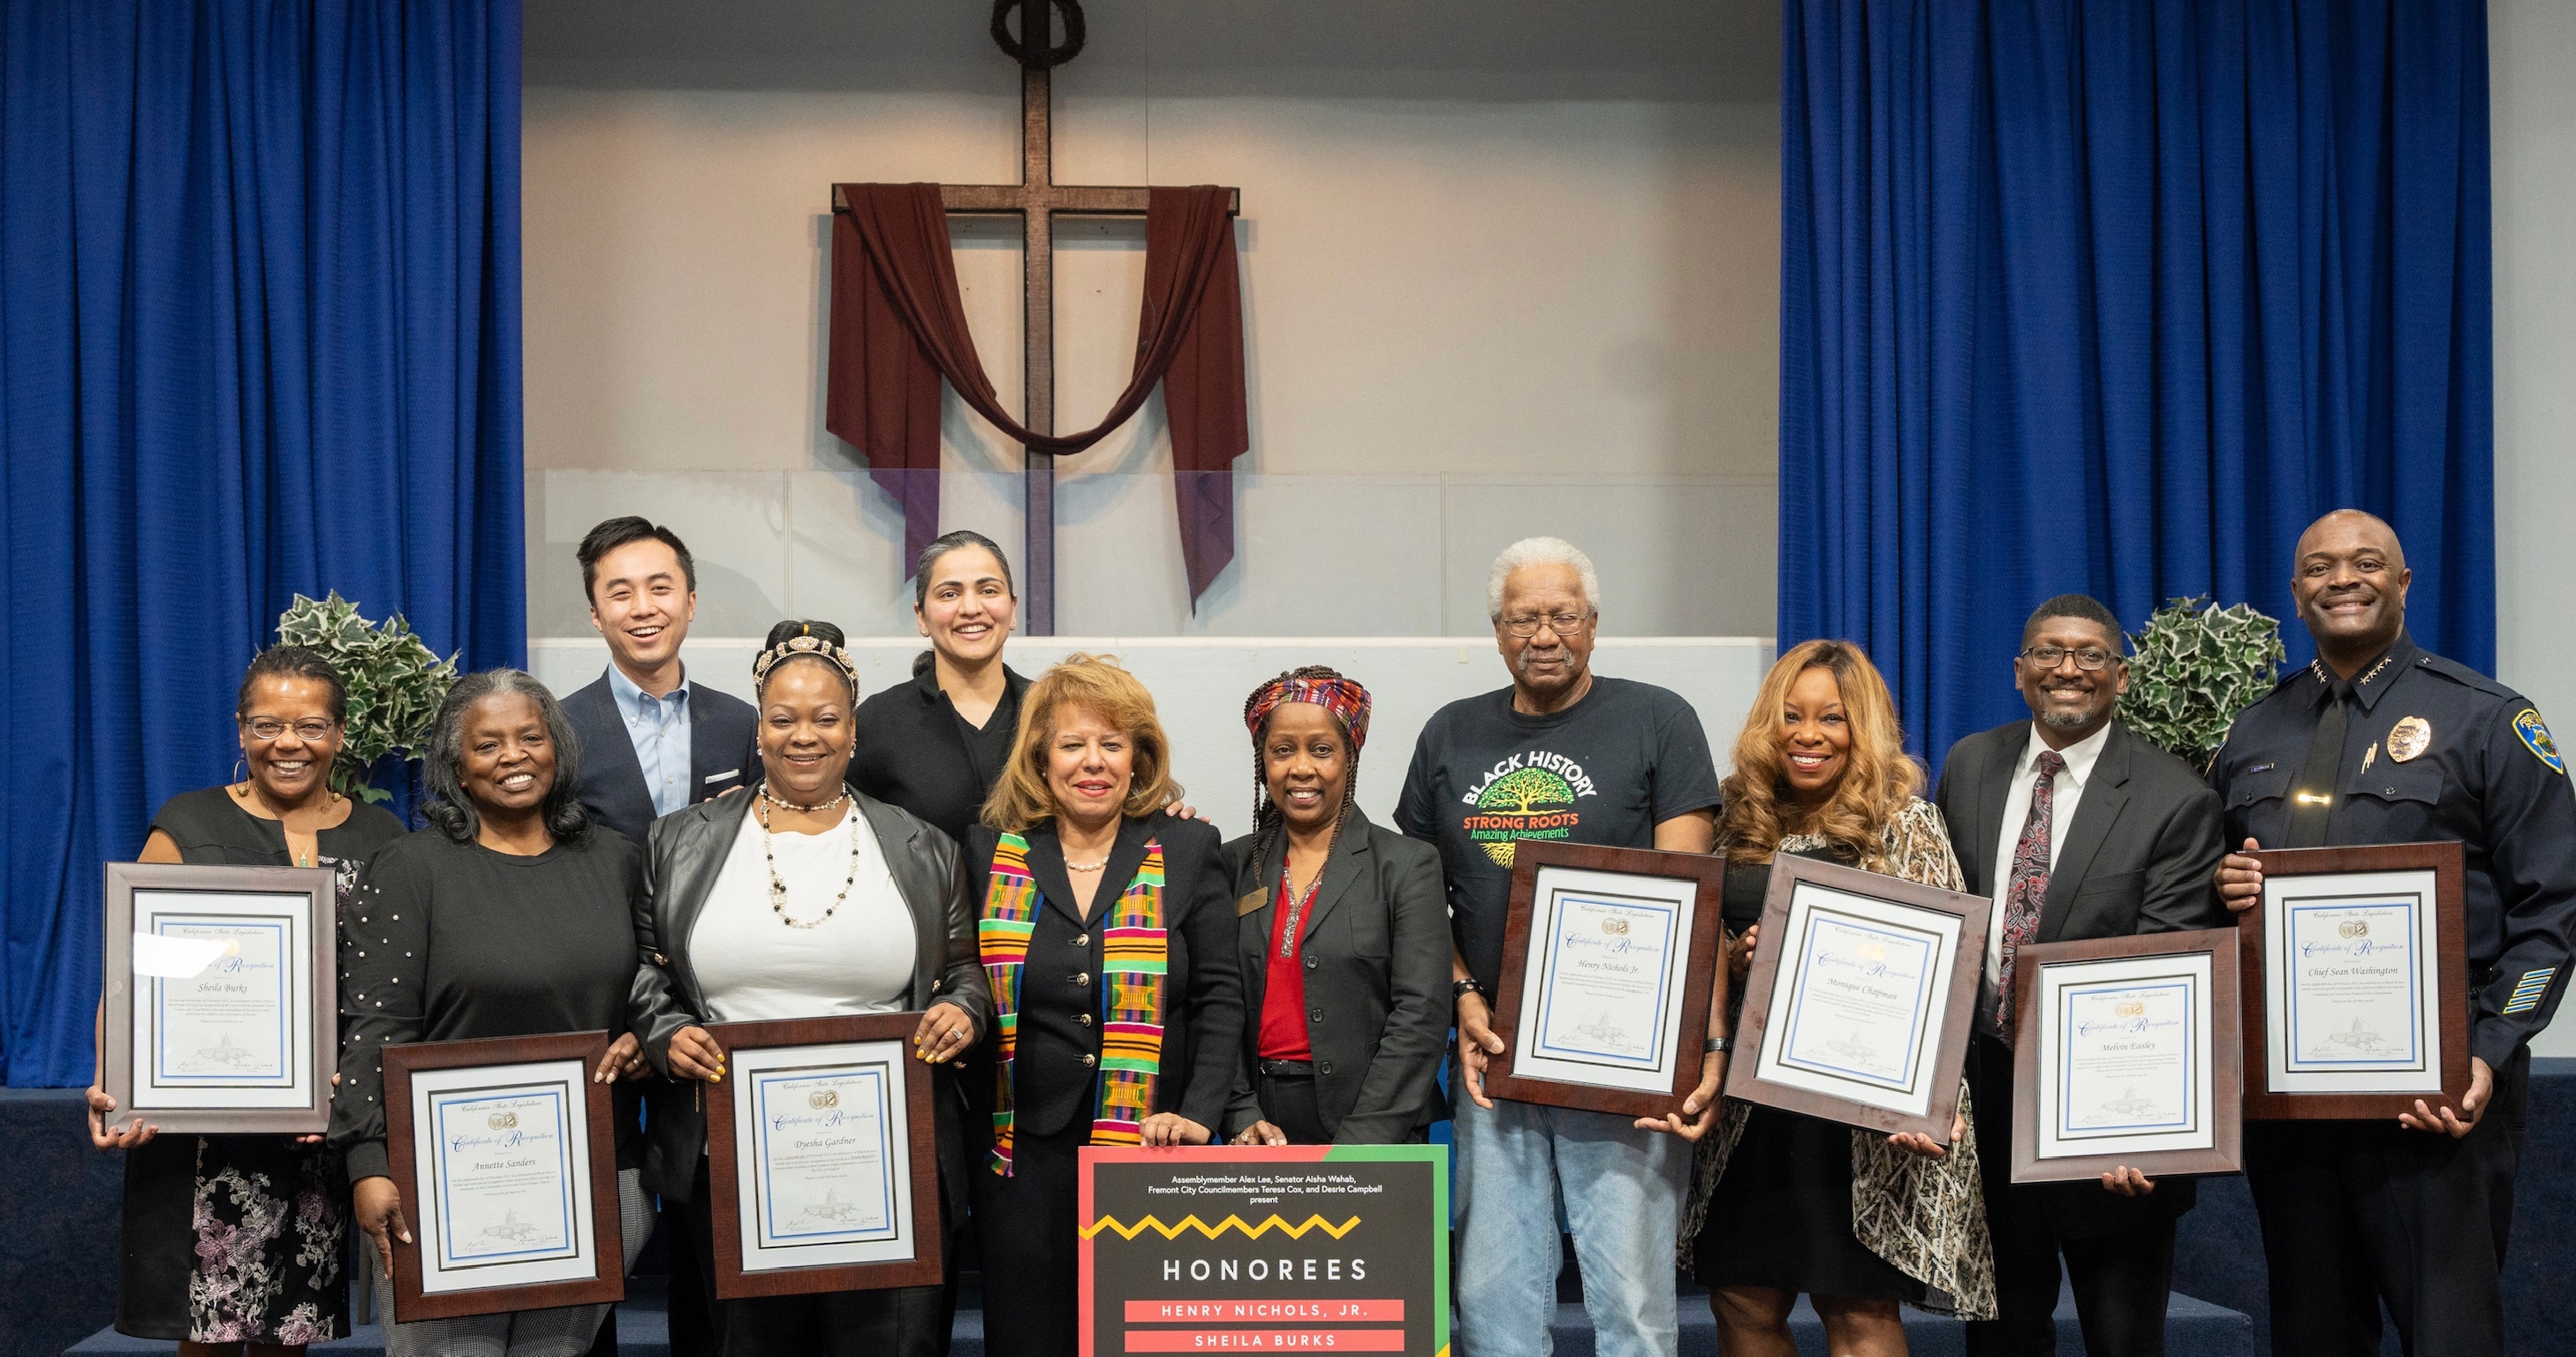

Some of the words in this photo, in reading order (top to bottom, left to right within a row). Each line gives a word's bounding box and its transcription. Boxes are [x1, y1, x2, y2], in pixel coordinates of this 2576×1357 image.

[1462, 753, 1523, 805] BLACK
[1527, 751, 1597, 798] HISTORY
[1463, 816, 1525, 829] STRONG
[1528, 813, 1579, 829] ROOTS
[1470, 829, 1508, 841] Amazing
[1510, 827, 1569, 839] Achievements
[1580, 905, 1607, 914] California
[1625, 909, 1654, 919] Legislature
[1565, 930, 1602, 949] Certificate
[1603, 940, 1612, 950] of
[1612, 936, 1660, 954] Recognition
[1834, 926, 1862, 936] California
[1881, 936, 1912, 947] Legislature
[2301, 940, 2342, 958] Certificate
[2344, 942, 2352, 953] of
[2353, 938, 2404, 956] Recognition
[214, 960, 224, 970] of
[224, 956, 274, 974] Recognition
[1578, 960, 1600, 971] Henry
[1601, 963, 1629, 973] Nichols
[1817, 950, 1857, 967] Certificate
[1858, 962, 1867, 971] of
[1867, 960, 1916, 980] Recognition
[2308, 967, 2330, 978] Chief
[2351, 967, 2398, 976] Washington
[197, 983, 222, 992] Sheila
[224, 983, 248, 994] Burks
[1827, 978, 1861, 991] Monique
[1861, 985, 1898, 1000] Chapman
[2078, 1020, 2118, 1036] Certificate
[2119, 1021, 2128, 1032] of
[2129, 1017, 2179, 1033] Recognition
[2101, 1042, 2128, 1051] Melvin
[2129, 1041, 2156, 1050] Easley
[783, 1082, 811, 1091] California
[831, 1078, 862, 1088] Legislature
[461, 1104, 490, 1113] California
[511, 1100, 542, 1110] Legislature
[772, 1113, 813, 1132] Certificate
[814, 1113, 824, 1126] of
[825, 1110, 875, 1127] Recognition
[451, 1134, 492, 1153] Certificate
[494, 1134, 504, 1146] of
[504, 1130, 554, 1148] Recognition
[794, 1138, 822, 1150] Dyesha
[824, 1136, 857, 1148] Gardner
[472, 1162, 504, 1171] Annette
[505, 1157, 536, 1168] Sanders
[1171, 1175, 1238, 1185] Assemblymember
[1239, 1175, 1255, 1184] Alex
[1257, 1175, 1273, 1185] Lee,
[1275, 1175, 1304, 1184] Senator
[1305, 1174, 1327, 1184] Aisha
[1328, 1174, 1357, 1185] Wahab,
[1148, 1186, 1179, 1194] Fremont
[1180, 1186, 1197, 1195] City
[1198, 1185, 1260, 1194] Councilmembers
[1261, 1185, 1285, 1194] Teresa
[1286, 1185, 1304, 1194] Cox,
[1306, 1185, 1321, 1194] and
[1322, 1185, 1346, 1194] Desrie
[1347, 1185, 1383, 1195] Campbell
[1249, 1196, 1279, 1206] present
[1163, 1258, 1366, 1281] HONOREES
[1162, 1305, 1223, 1316] HENRY
[1235, 1304, 1328, 1318] NICHOLS,
[1339, 1304, 1368, 1315] JR.
[1195, 1336, 1262, 1346] SHEILA
[1275, 1335, 1335, 1346] BURKS
